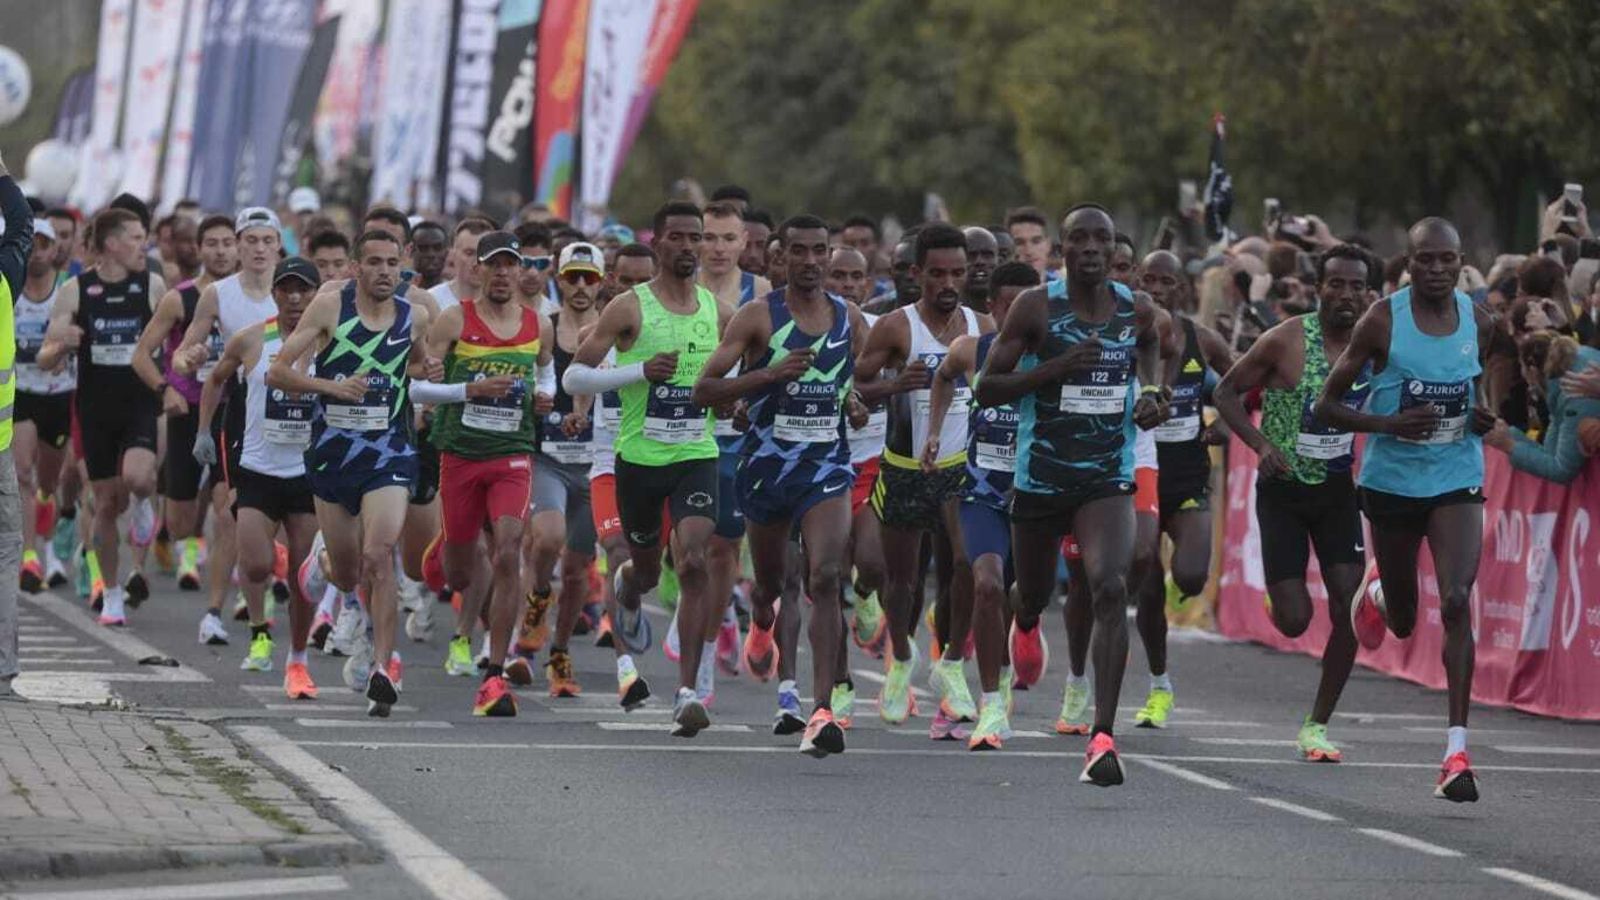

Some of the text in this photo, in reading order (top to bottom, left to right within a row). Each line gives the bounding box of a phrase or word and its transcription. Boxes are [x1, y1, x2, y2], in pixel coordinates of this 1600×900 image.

[1091, 371, 1109, 382] 122
[1425, 384, 1465, 394] ZURICH
[805, 404, 818, 414] 29
